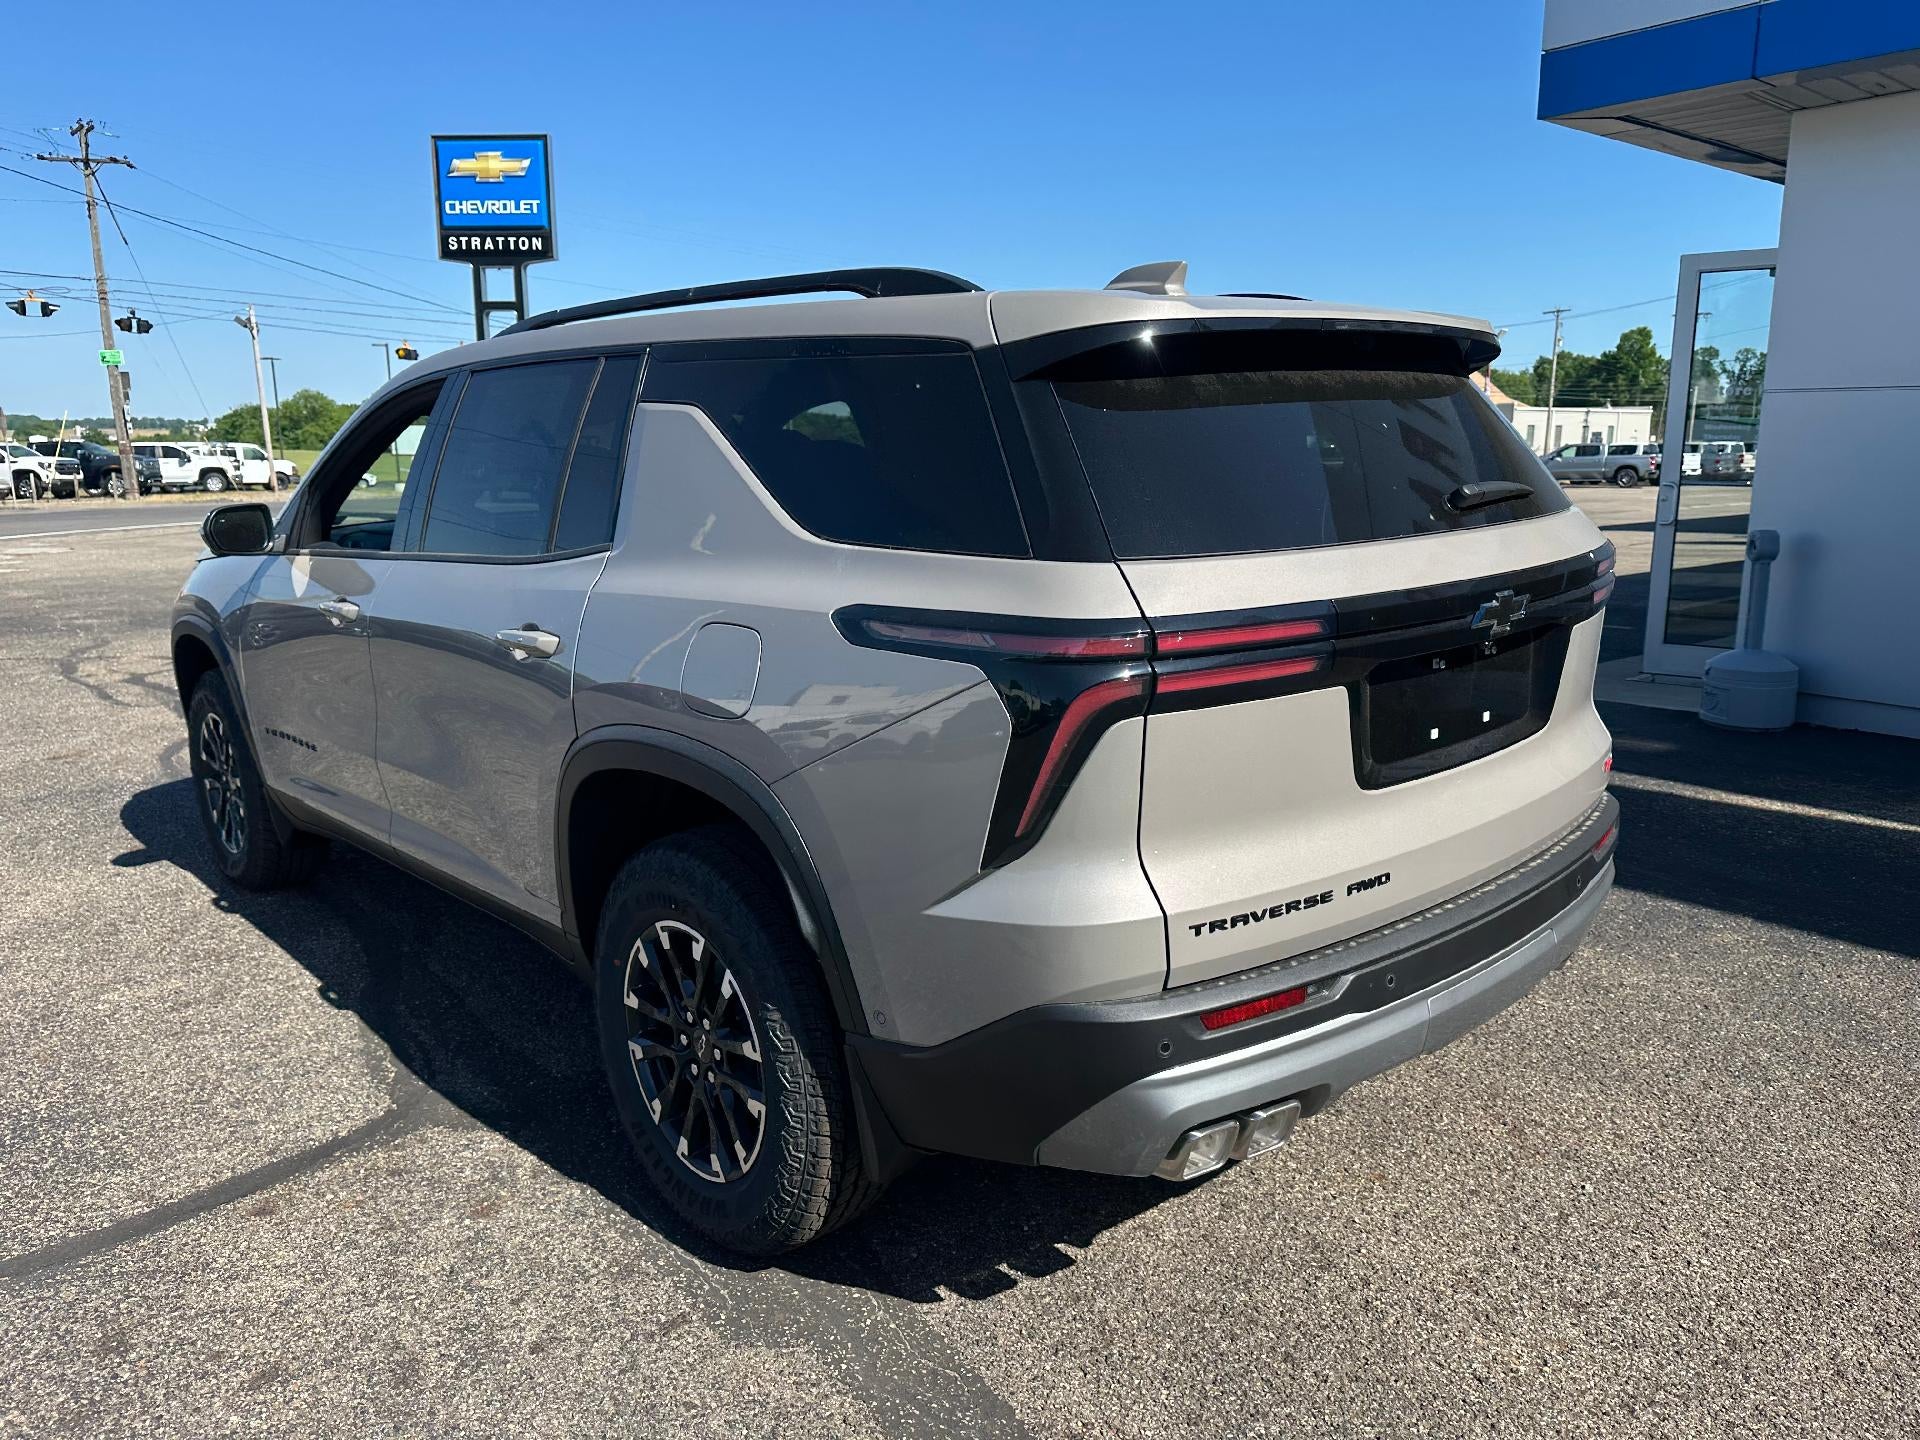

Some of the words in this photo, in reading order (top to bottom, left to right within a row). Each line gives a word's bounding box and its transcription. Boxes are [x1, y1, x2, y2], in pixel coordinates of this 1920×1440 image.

[444, 199, 541, 215] CHEVROLET
[448, 236, 543, 251] STRATTON
[1188, 889, 1335, 937] TRAVERSE
[1346, 871, 1391, 897] AWD
